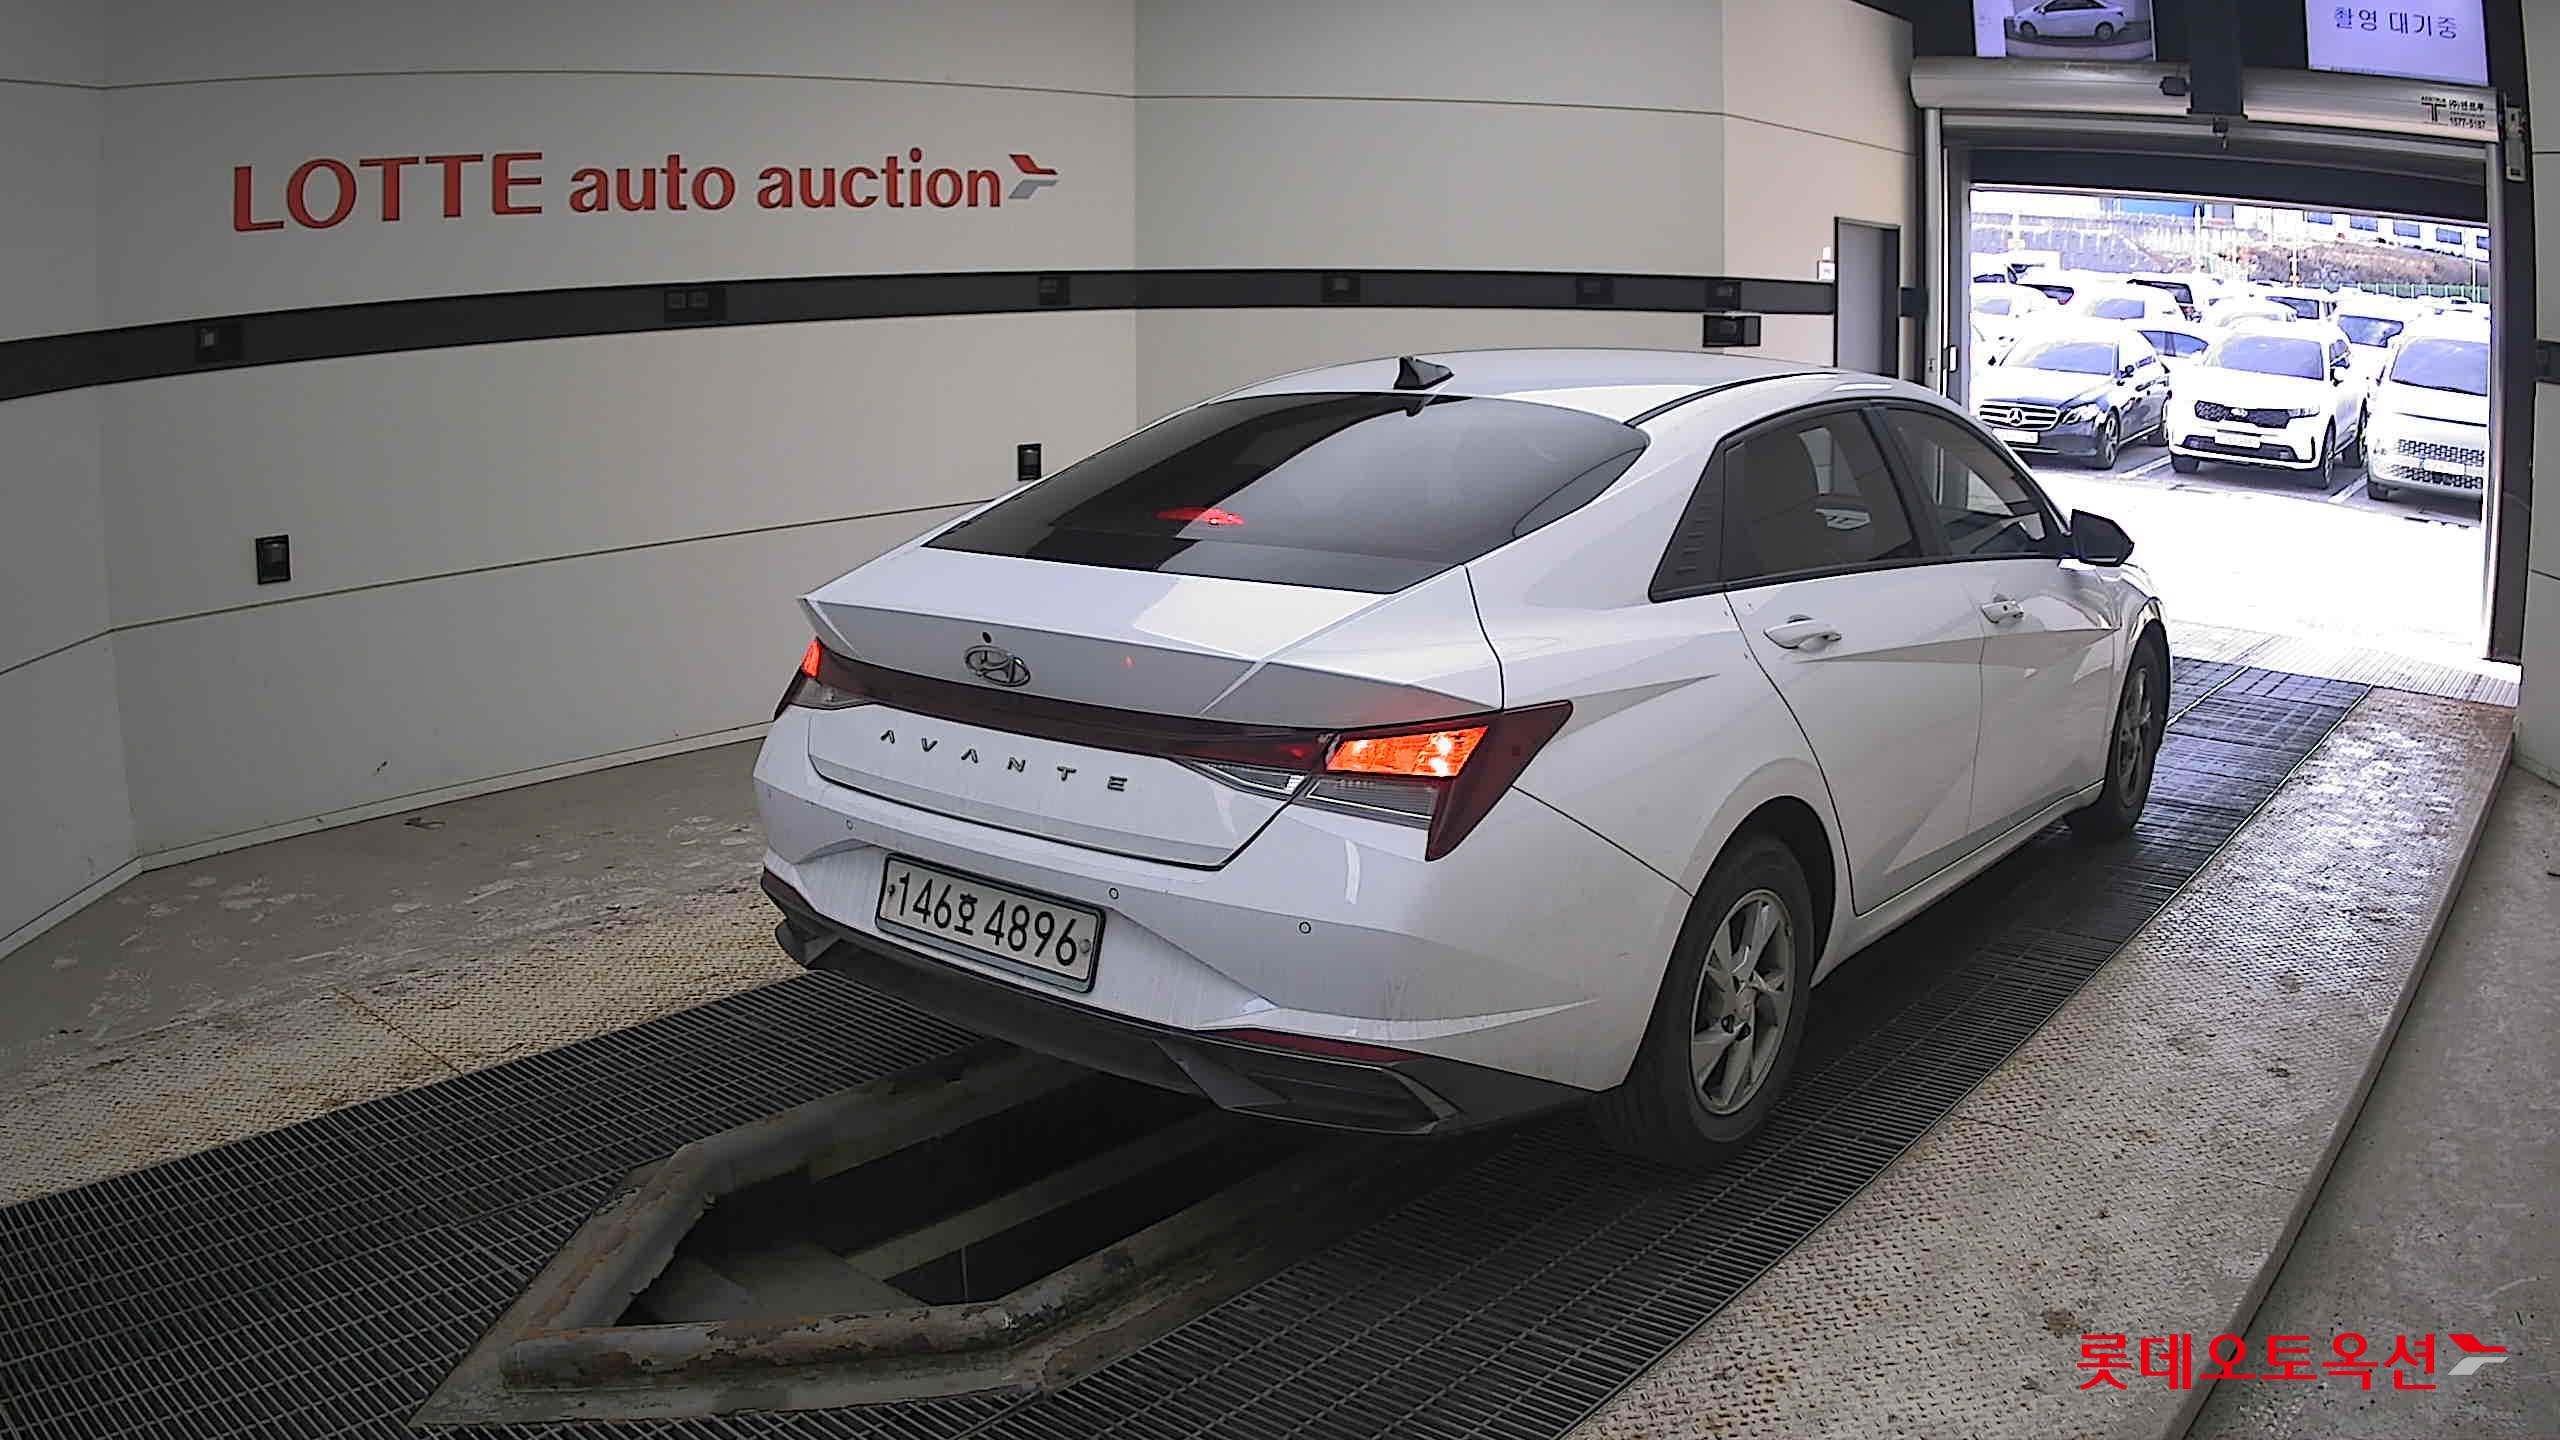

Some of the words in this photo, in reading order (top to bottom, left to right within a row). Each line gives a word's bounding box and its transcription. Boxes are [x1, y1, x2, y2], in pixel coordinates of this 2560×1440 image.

[2335, 6, 2378, 31] 촬영
[2389, 12, 2457, 39] 대기중
[234, 152, 543, 232] LOTTE
[569, 153, 736, 213] auto
[757, 147, 1001, 211] auction
[880, 727, 1129, 793] AVANTE
[897, 871, 978, 937] 146호
[983, 899, 1079, 968] 4896
